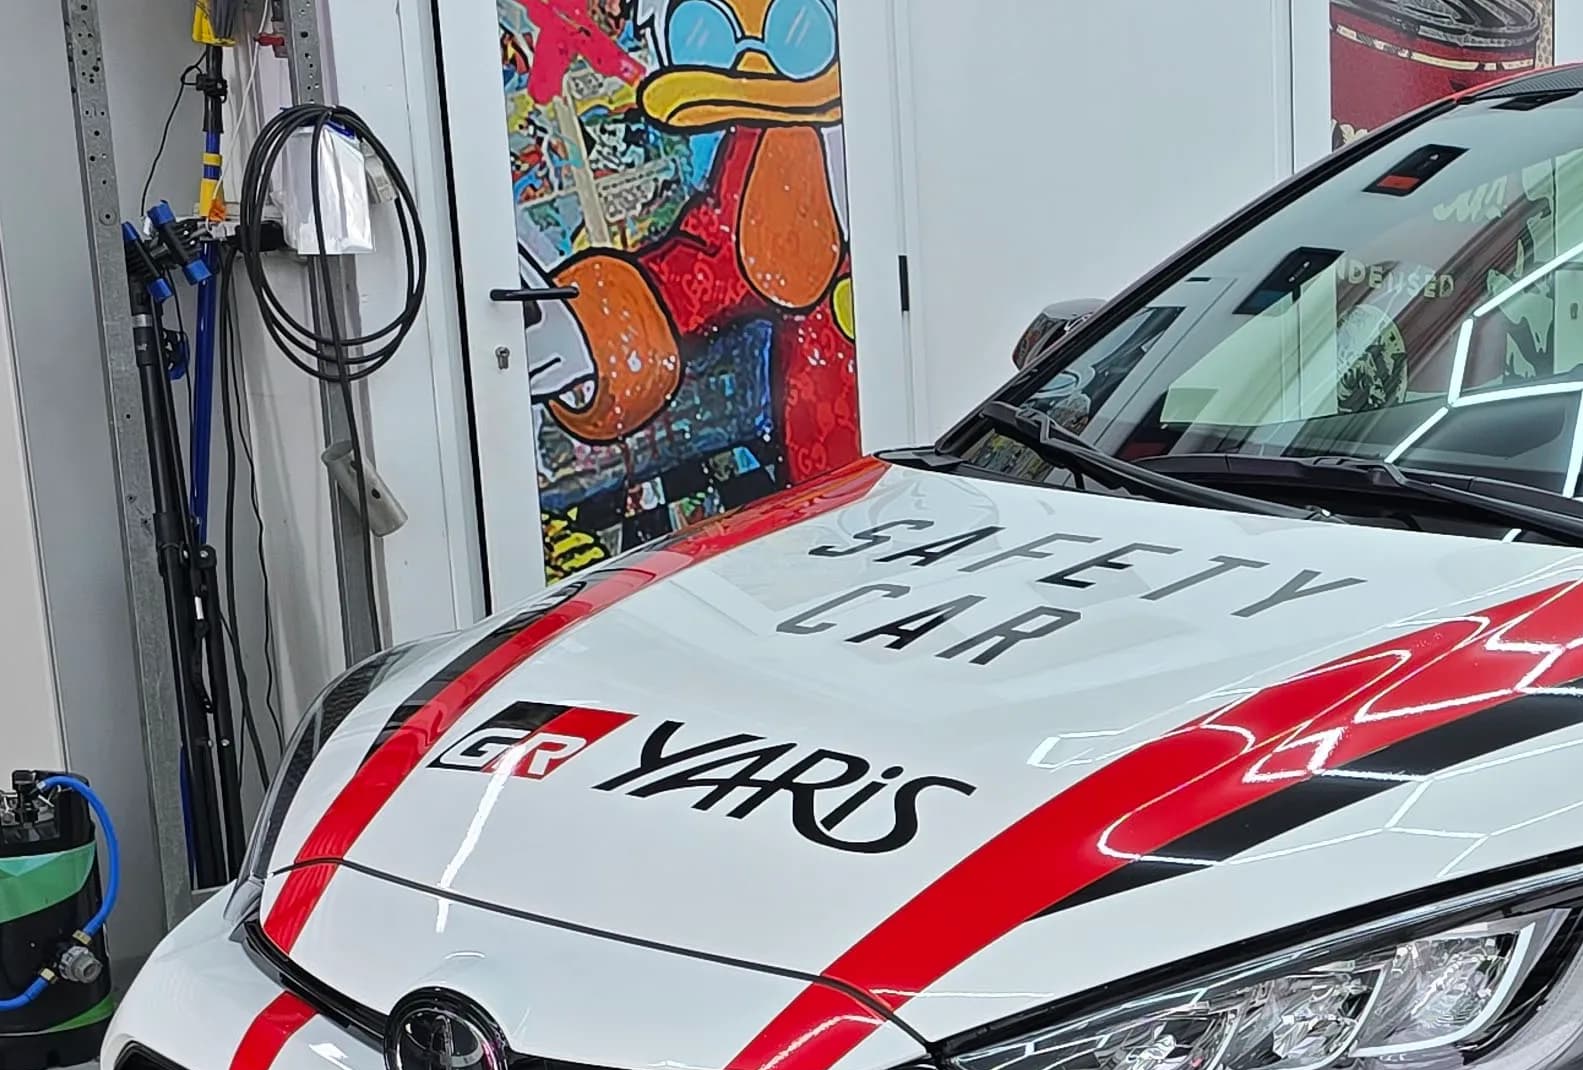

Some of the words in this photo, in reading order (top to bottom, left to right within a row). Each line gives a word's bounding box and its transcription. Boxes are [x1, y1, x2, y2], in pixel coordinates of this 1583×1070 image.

[808, 519, 1368, 619] SAFETY
[776, 584, 1082, 666] CAR
[438, 727, 589, 777] GR
